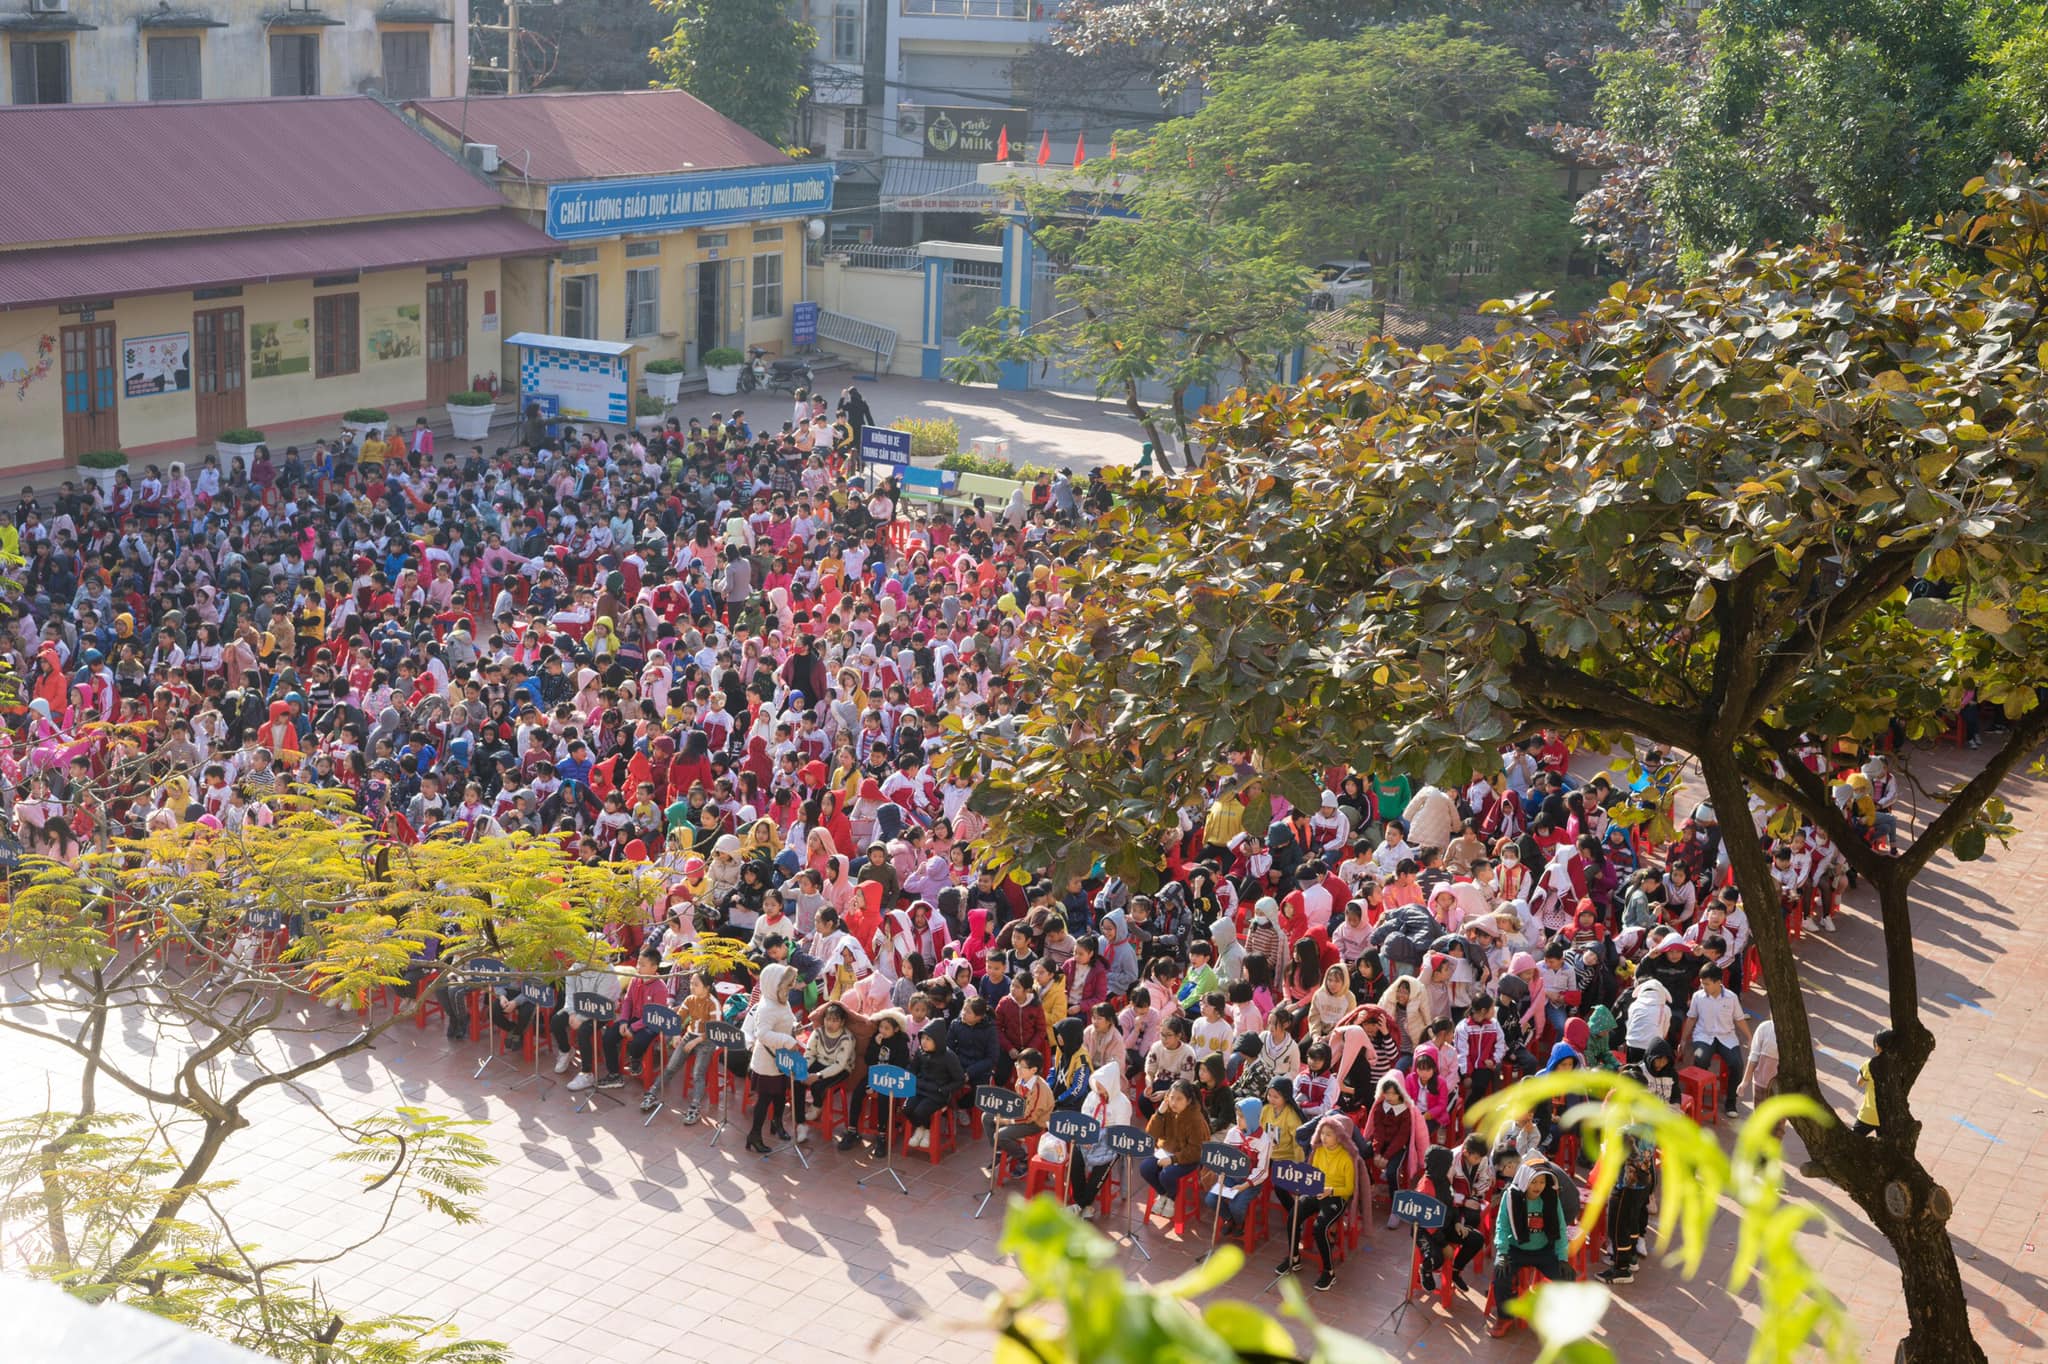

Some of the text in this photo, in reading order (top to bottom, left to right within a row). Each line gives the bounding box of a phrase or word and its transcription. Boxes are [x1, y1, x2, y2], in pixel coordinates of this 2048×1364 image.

[960, 137, 993, 151] Milk
[560, 177, 825, 226] CHẤT LƯỢNG GIÁO DỤC LÀM NÊN THƯƠNG HIỆU NHÀ TRƯỜNG
[579, 998, 598, 1013] LỚP
[647, 1011, 664, 1026] LỚP
[709, 1027, 727, 1042] LỚP
[778, 1053, 794, 1070] LỚP
[873, 1071, 896, 1088] LỚP
[980, 1093, 1002, 1109] LỚP
[1056, 1119, 1078, 1136] LỚP
[1112, 1133, 1134, 1150] LỚP
[1206, 1150, 1229, 1168] LỚP
[1276, 1164, 1303, 1182] LỚP
[1397, 1199, 1422, 1217] LỚP
